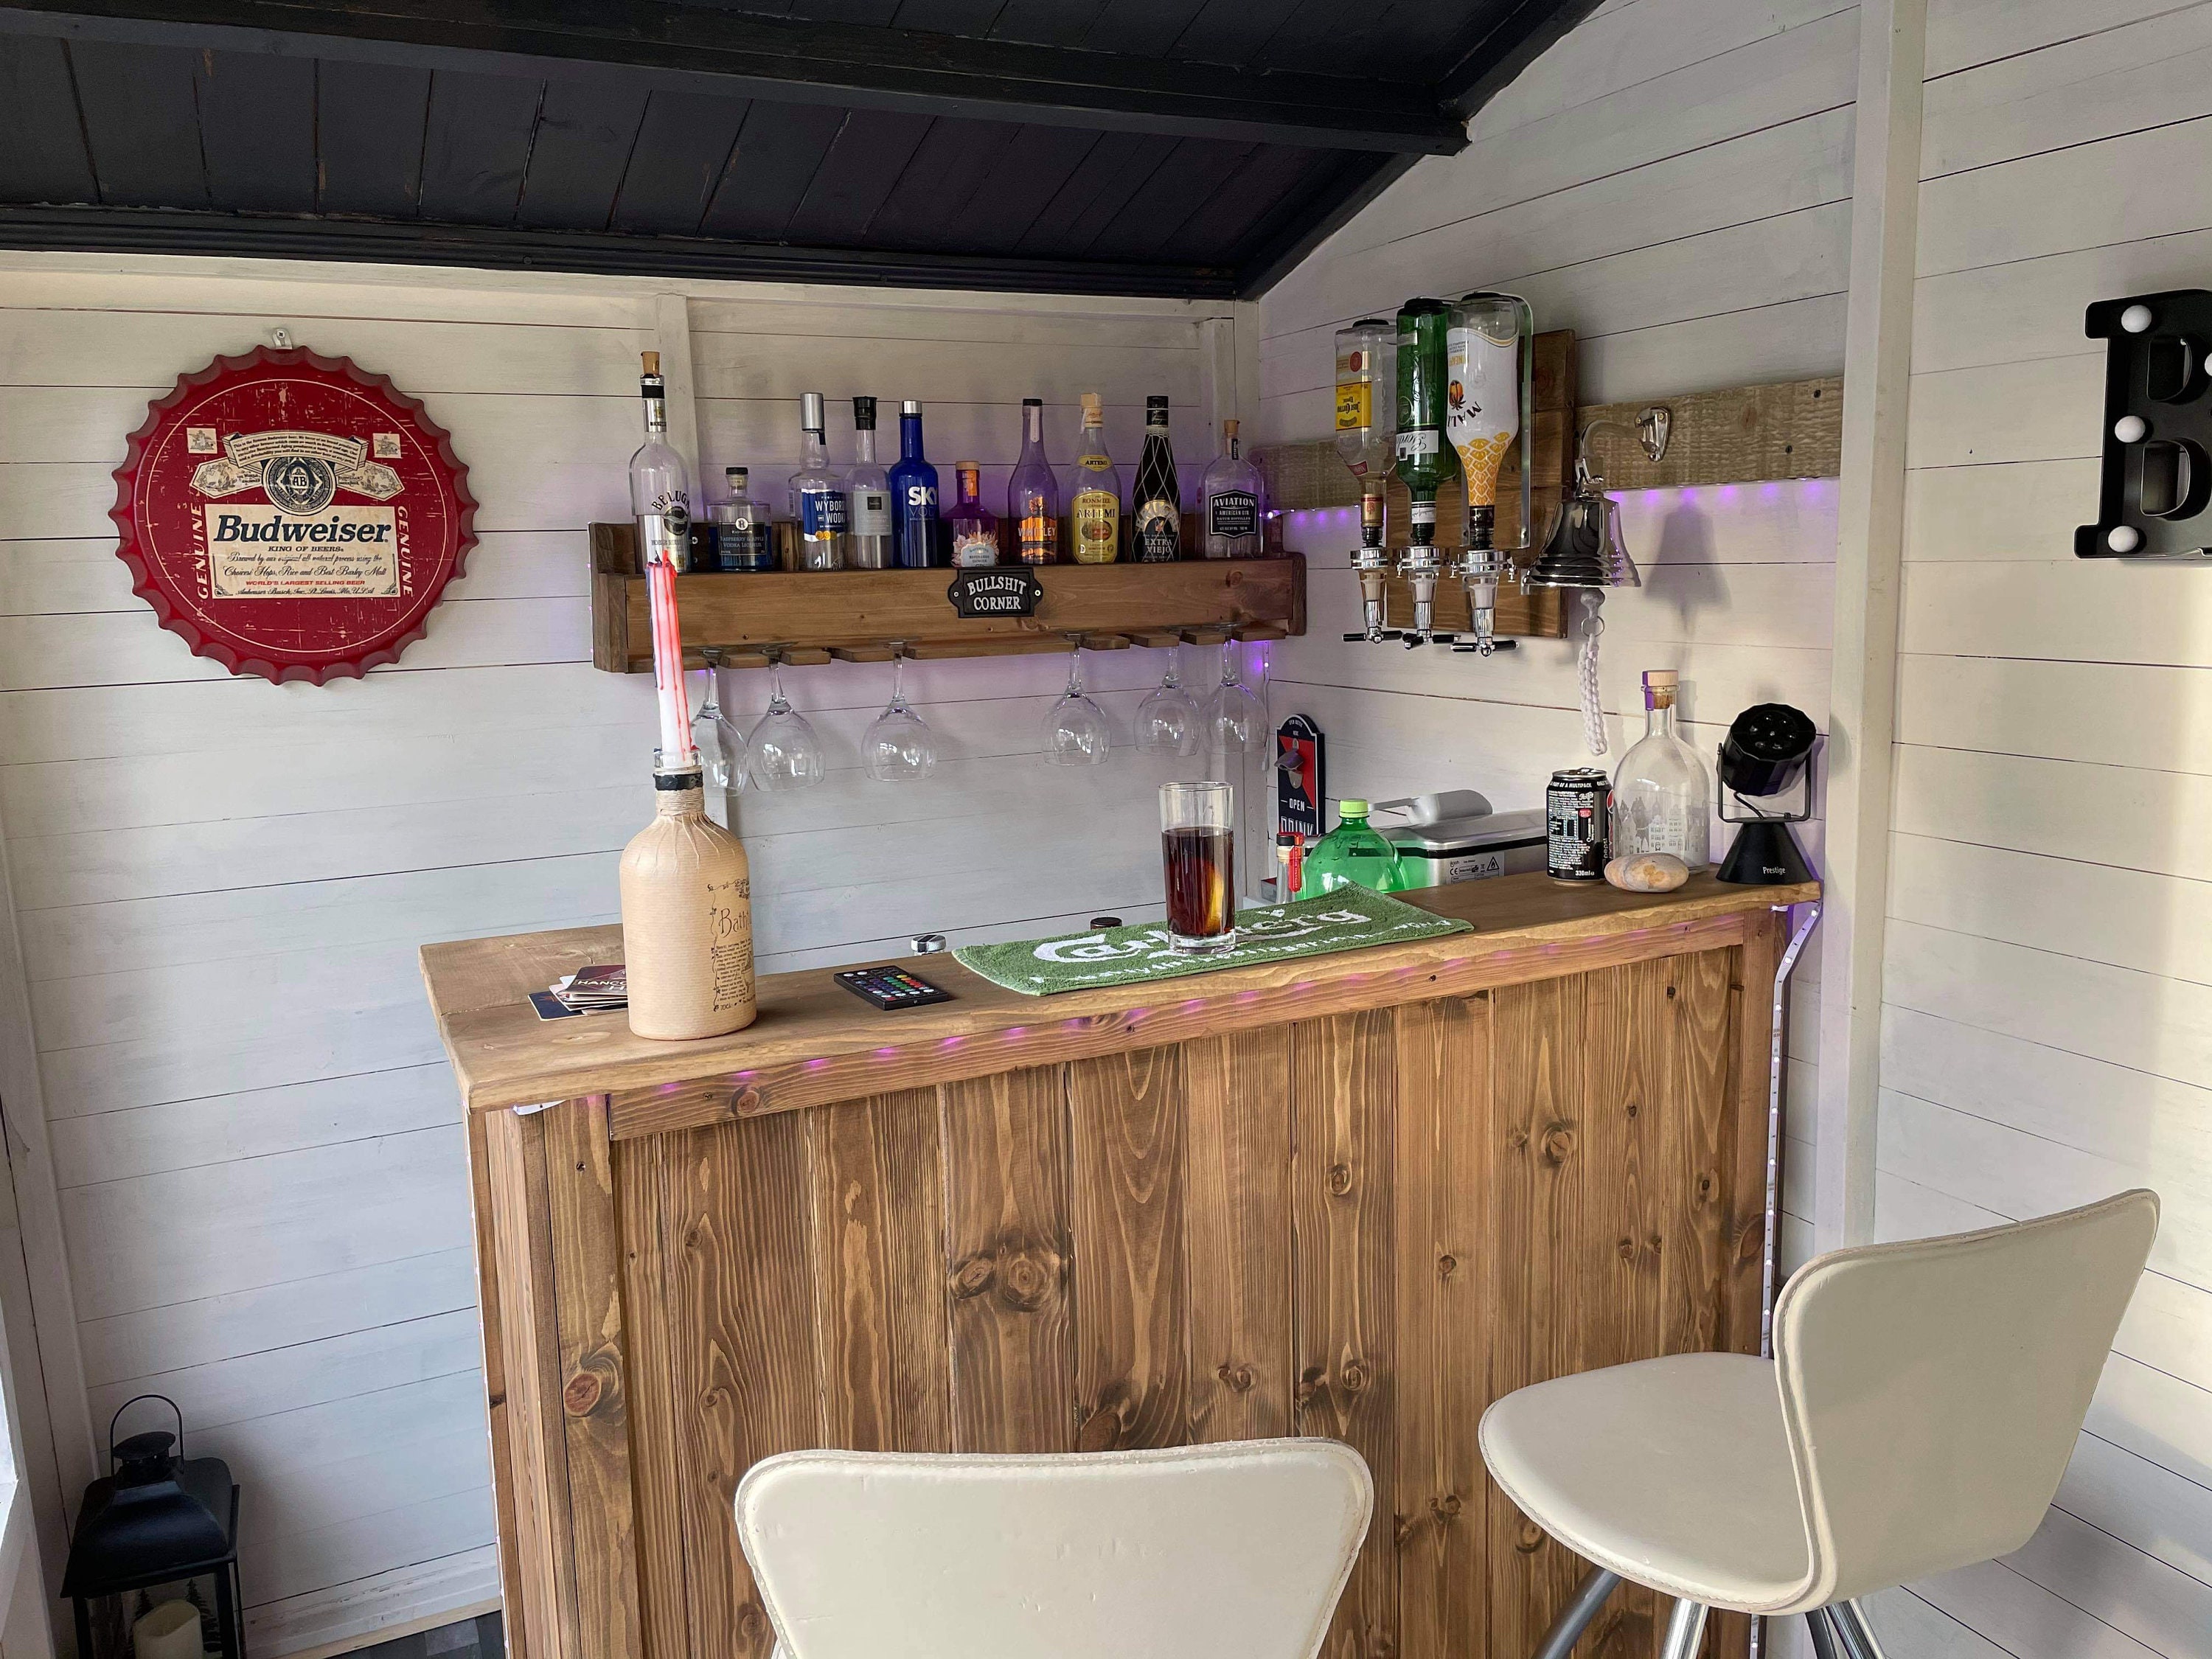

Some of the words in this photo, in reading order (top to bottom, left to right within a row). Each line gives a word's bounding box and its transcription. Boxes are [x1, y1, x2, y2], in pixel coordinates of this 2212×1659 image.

[1214, 497, 1254, 507] AVIATION
[213, 515, 392, 543] Budweiser
[190, 503, 209, 599] GENUINE
[398, 506, 414, 598] GENUINE
[1147, 546, 1172, 554] VIEJO
[279, 565, 299, 576] Rice
[314, 565, 335, 576] Best
[967, 576, 1026, 596] BULLSHIT
[974, 596, 1021, 611] CORNER
[1289, 798, 1305, 812] OPEN
[1762, 866, 1786, 875] Prestige
